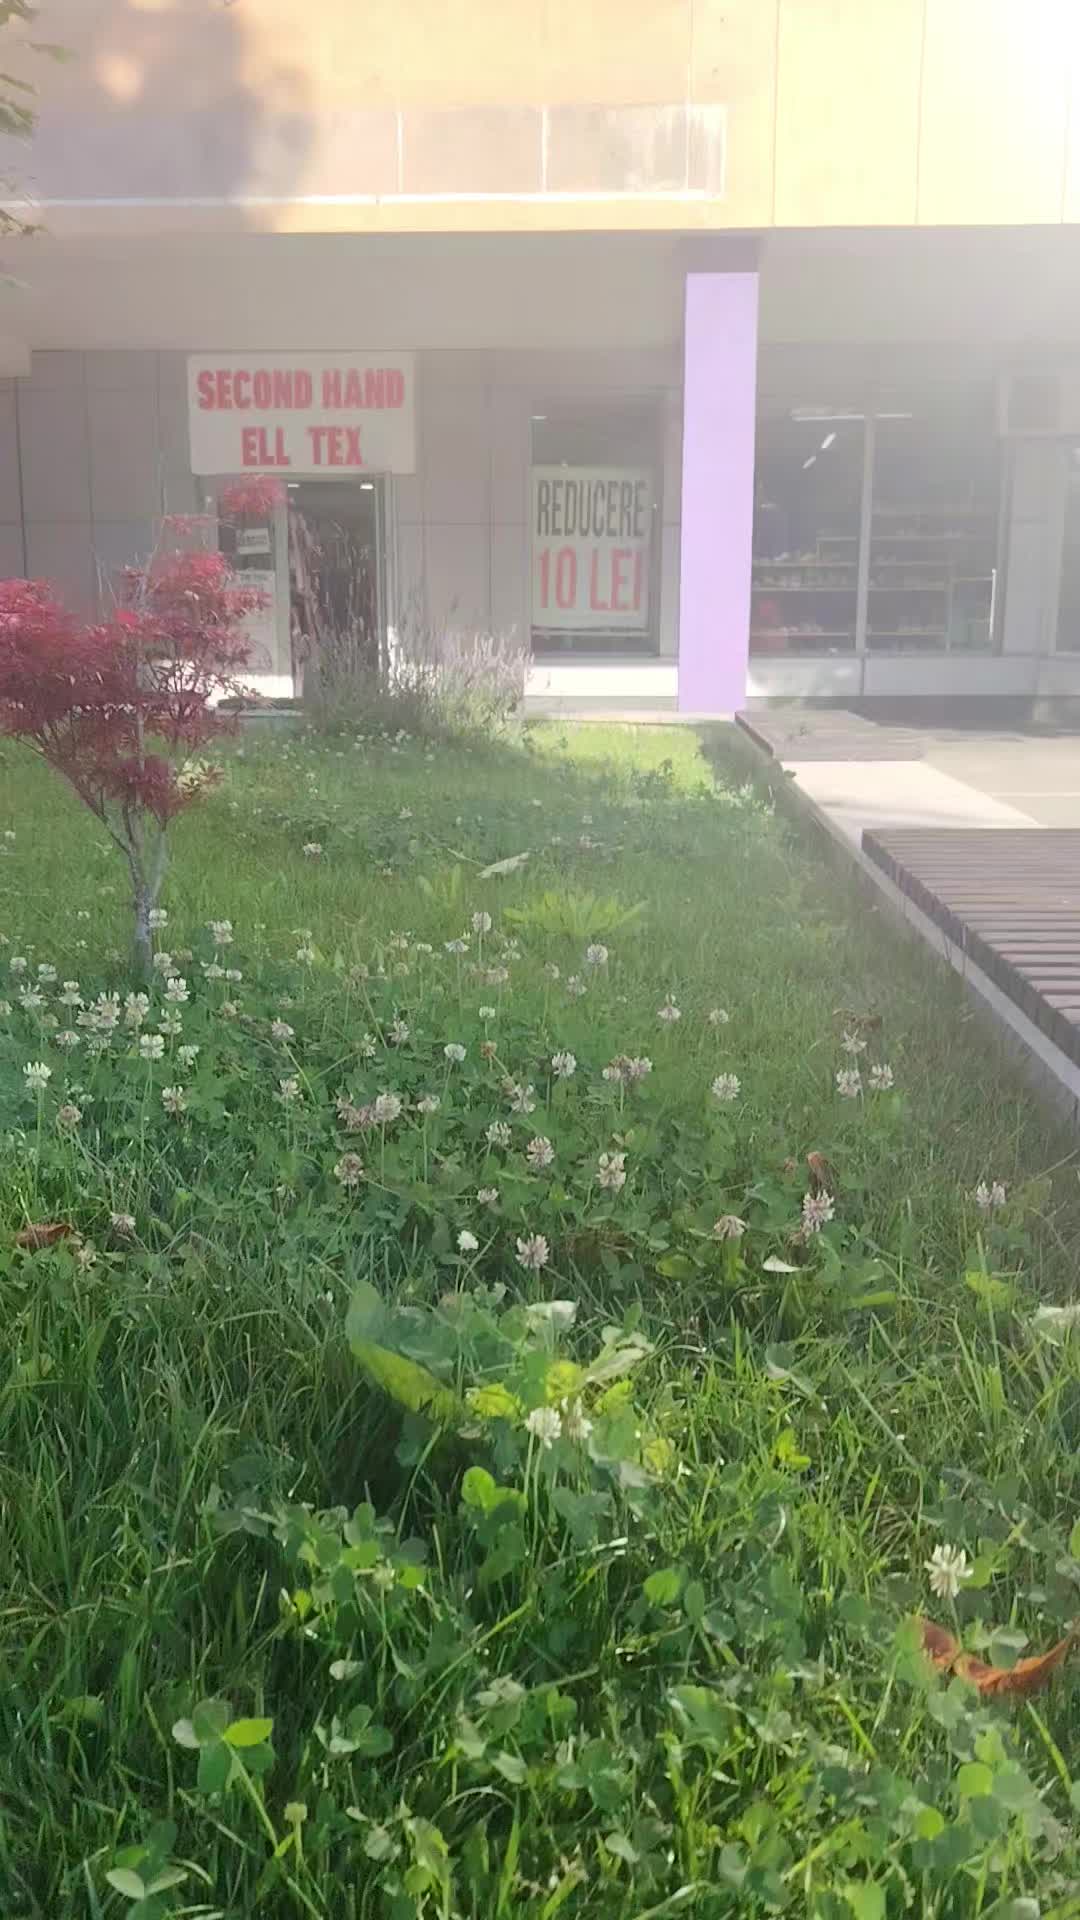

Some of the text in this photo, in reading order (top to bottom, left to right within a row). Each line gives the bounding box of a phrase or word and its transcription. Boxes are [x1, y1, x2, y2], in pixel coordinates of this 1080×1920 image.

[196, 368, 405, 410] SECOND HAND
[241, 425, 363, 466] ELL TEX
[537, 479, 647, 537] REDUCERE
[538, 546, 641, 611] 10 LEI
